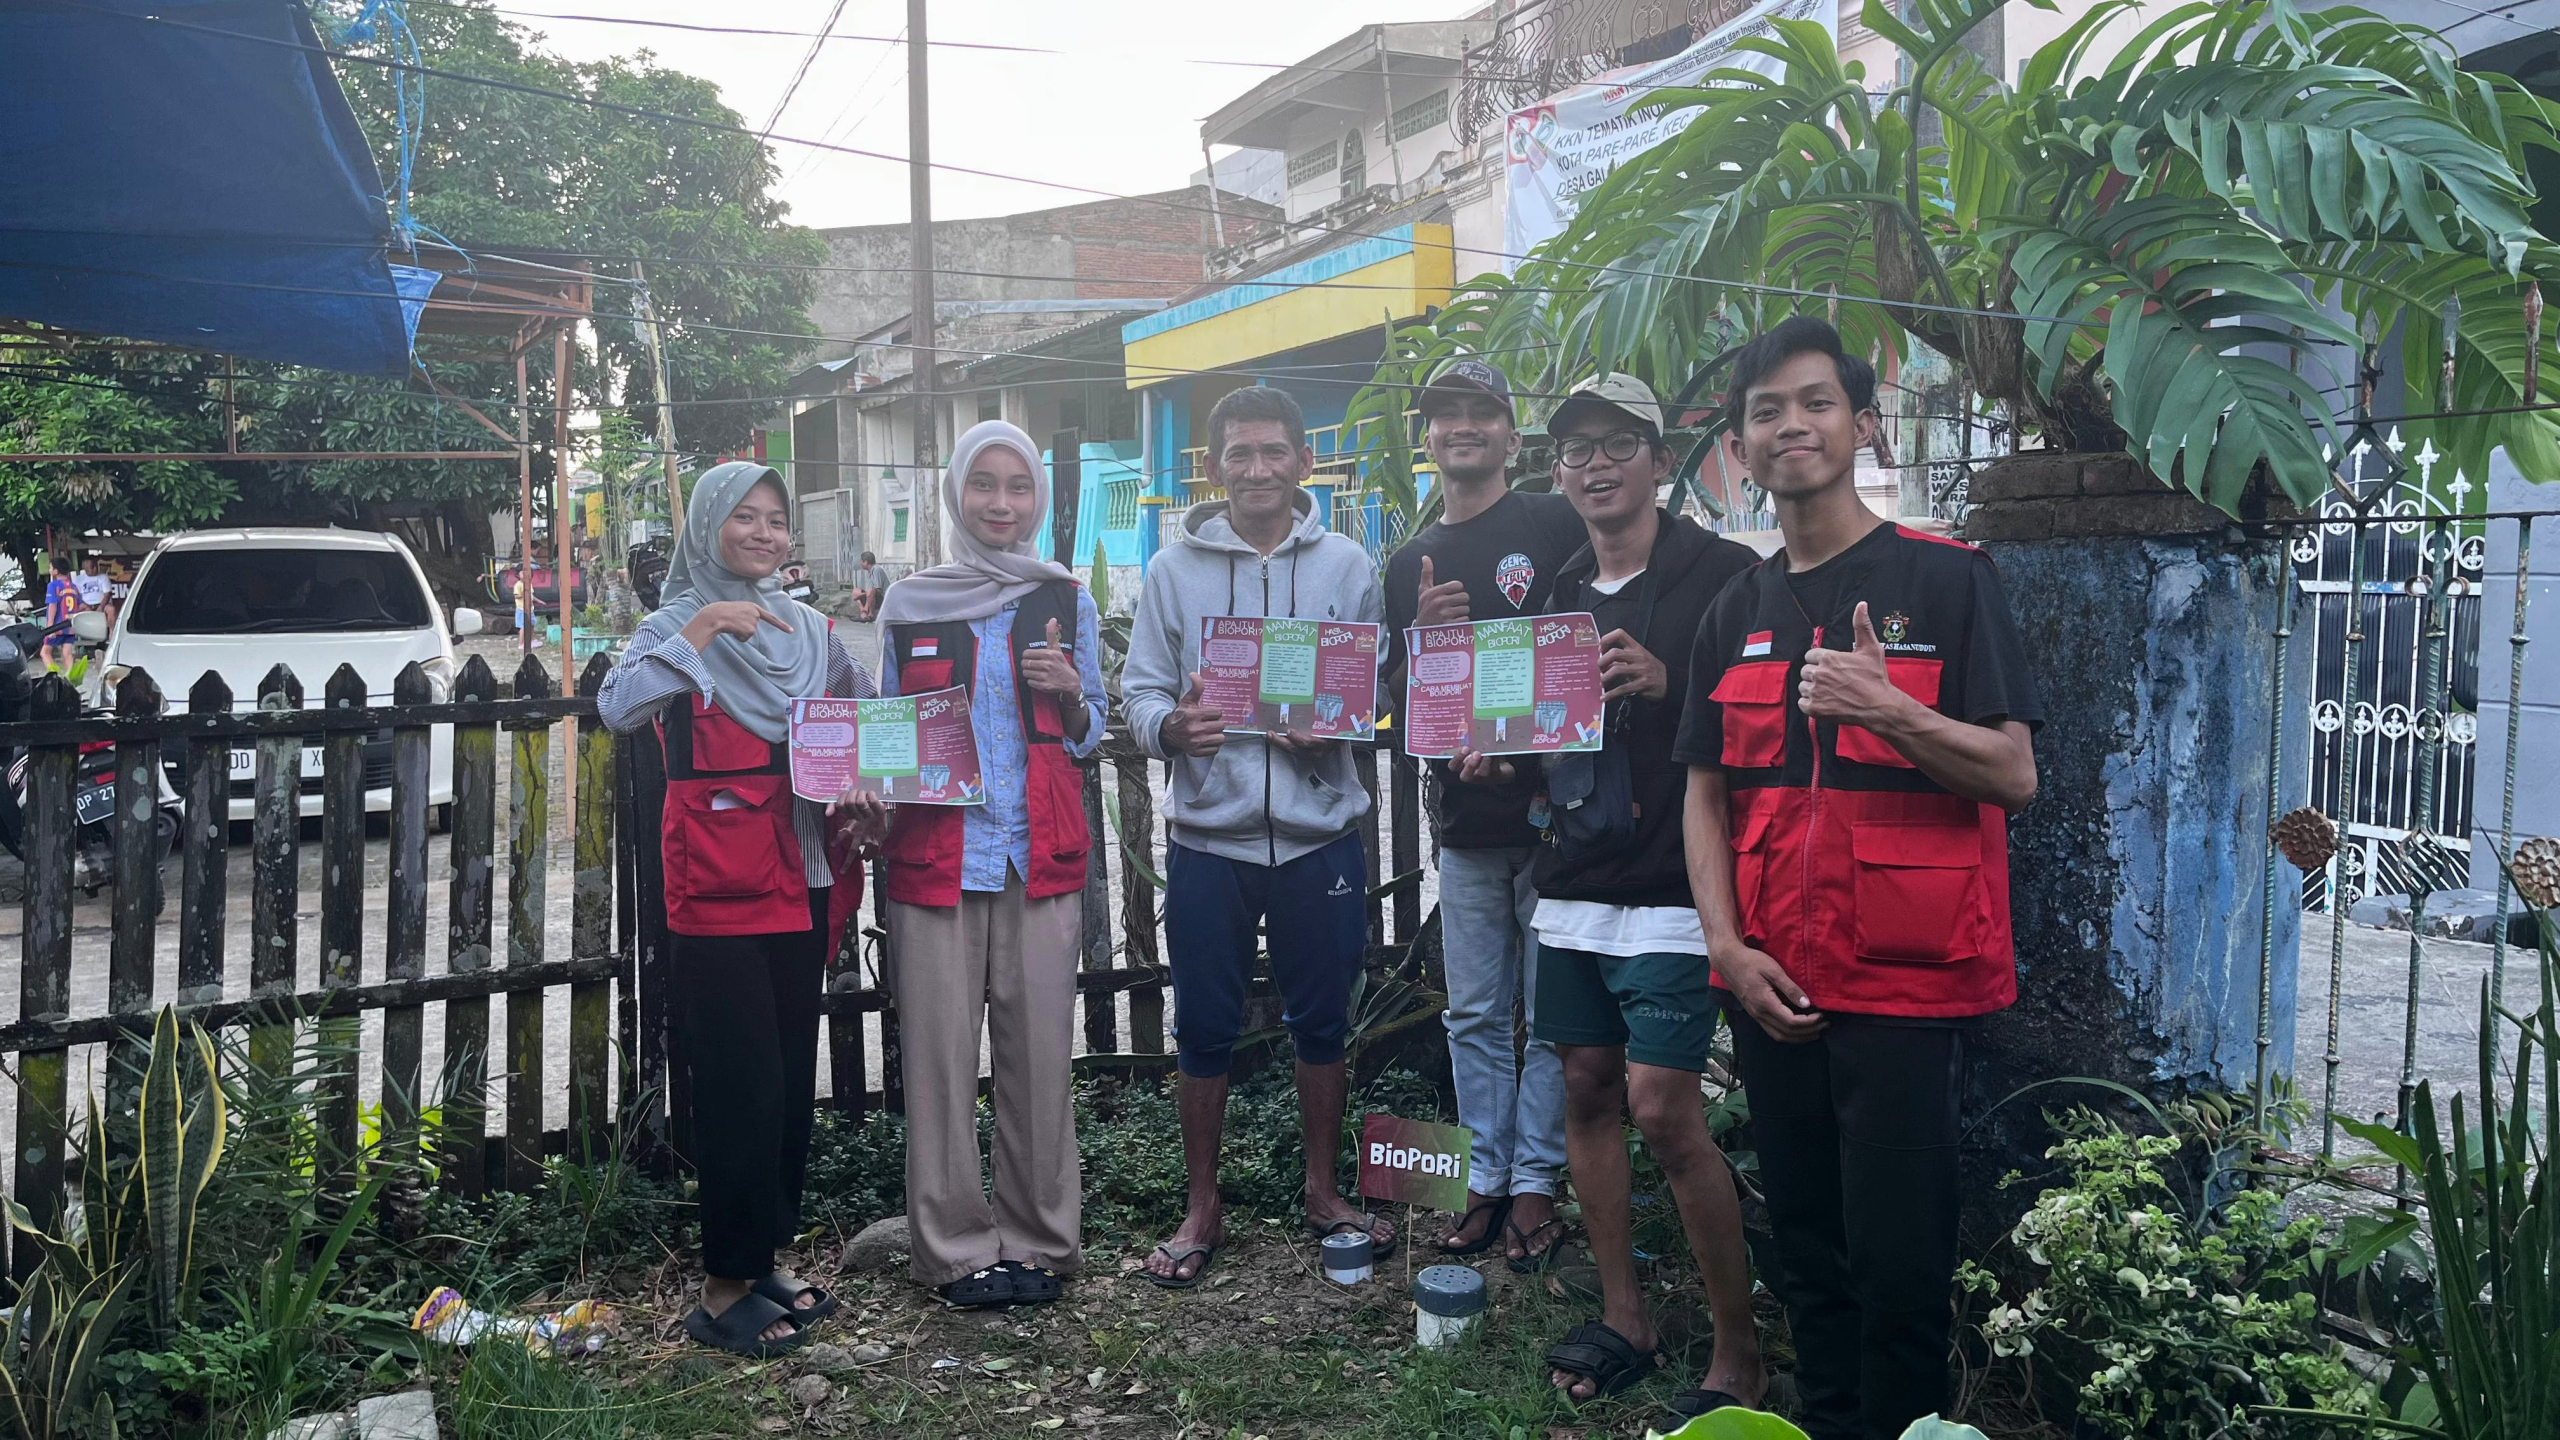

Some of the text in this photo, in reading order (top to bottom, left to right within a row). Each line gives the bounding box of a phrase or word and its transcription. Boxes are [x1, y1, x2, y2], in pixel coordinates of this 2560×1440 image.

[1728, 31, 1741, 44] dan
[1741, 19, 1767, 39] Inovasi
[1554, 130, 1584, 149] KKN
[1556, 151, 1582, 173] KOTA
[1584, 126, 1659, 164] PARE-PARE,
[1556, 174, 1585, 196] DESA
[66, 596, 74, 612] 9
[1218, 627, 1263, 636] BIOPORI?
[1266, 620, 1317, 637] MANFAAT
[1477, 621, 1532, 640] MANFAAT
[1275, 633, 1305, 642] BIOPORI
[1426, 636, 1475, 647] BIOPORI?
[1487, 636, 1520, 648] BIOPORI
[1894, 643, 1936, 653] HASANUDDIN
[809, 710, 858, 718] BIOPORI?
[861, 700, 915, 715] MANFAAT
[871, 712, 904, 722] BIOPORI
